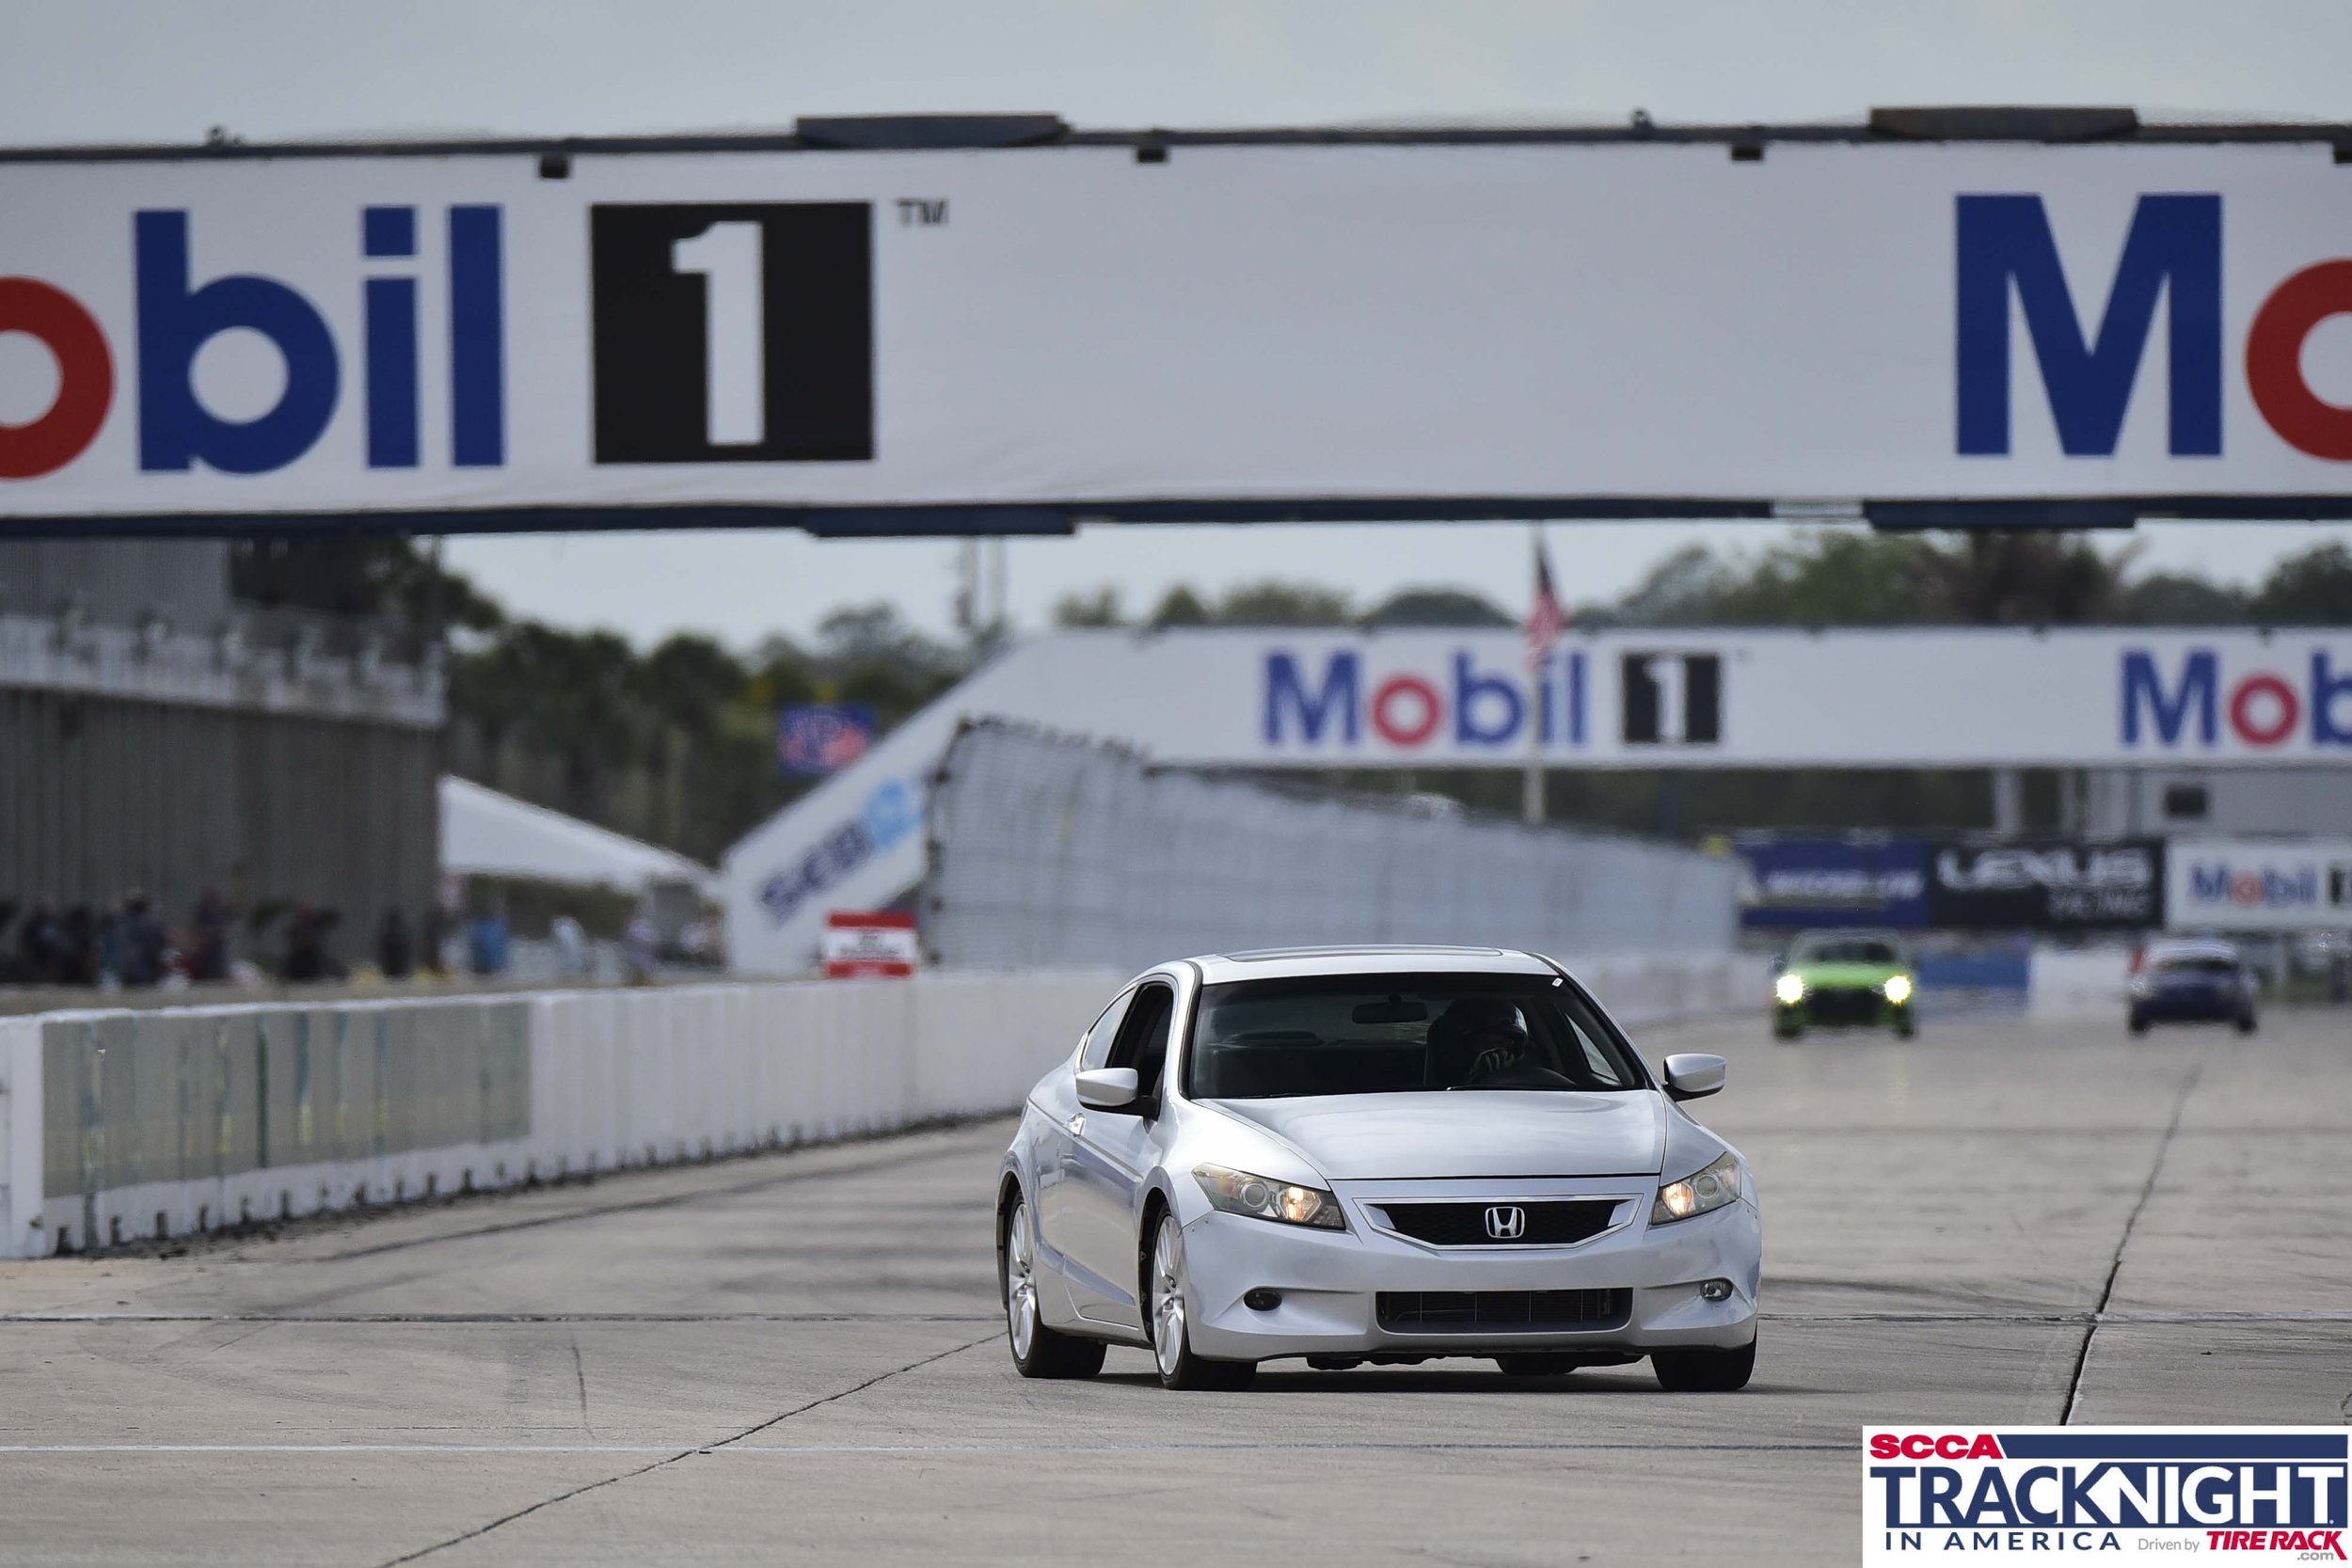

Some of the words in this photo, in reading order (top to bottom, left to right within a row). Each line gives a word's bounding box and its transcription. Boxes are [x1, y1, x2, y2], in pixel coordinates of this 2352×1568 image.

[670, 220, 766, 447] 1
[896, 198, 948, 226] TM
[1261, 649, 1588, 747] Mobil
